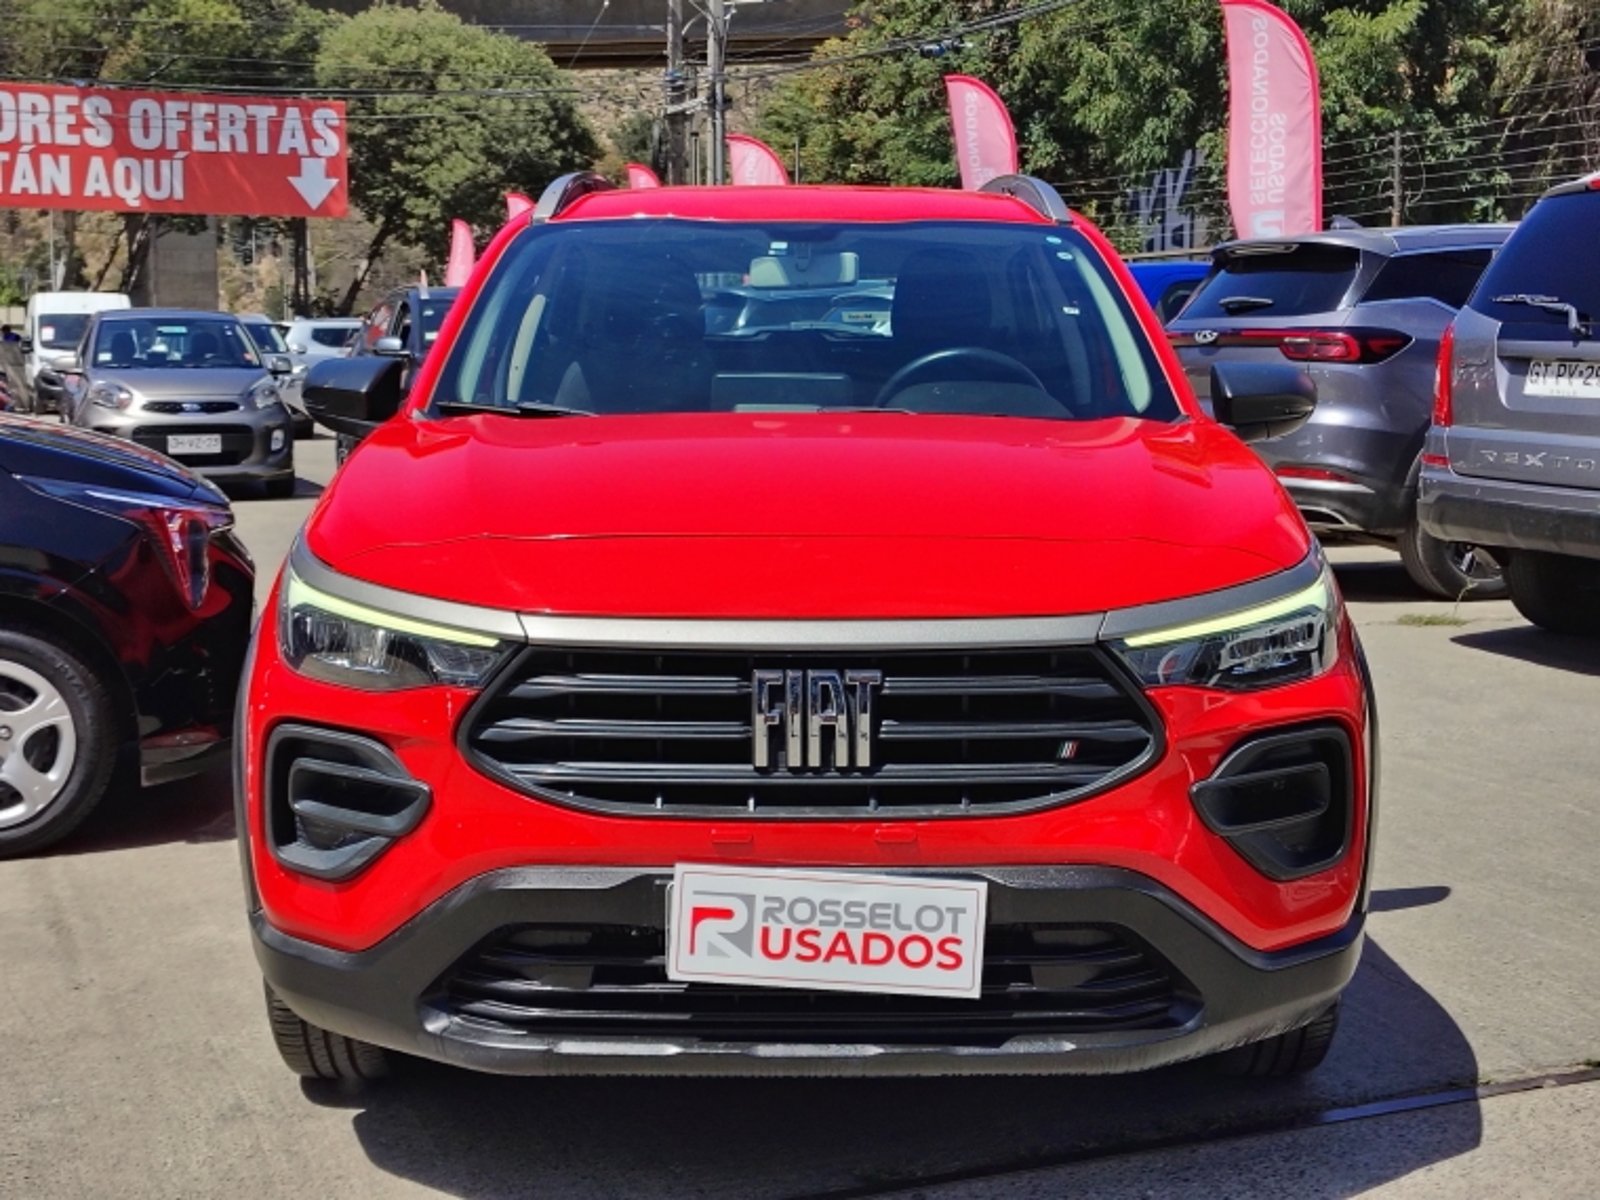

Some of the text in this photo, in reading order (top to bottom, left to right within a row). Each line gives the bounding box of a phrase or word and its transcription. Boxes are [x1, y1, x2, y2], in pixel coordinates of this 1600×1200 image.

[128, 98, 341, 158] OFERTAS
[83, 151, 190, 207] AQUÍ
[752, 669, 882, 768] FIAT
[761, 895, 968, 934] ROSSELOT
[760, 926, 963, 972] USADOS
